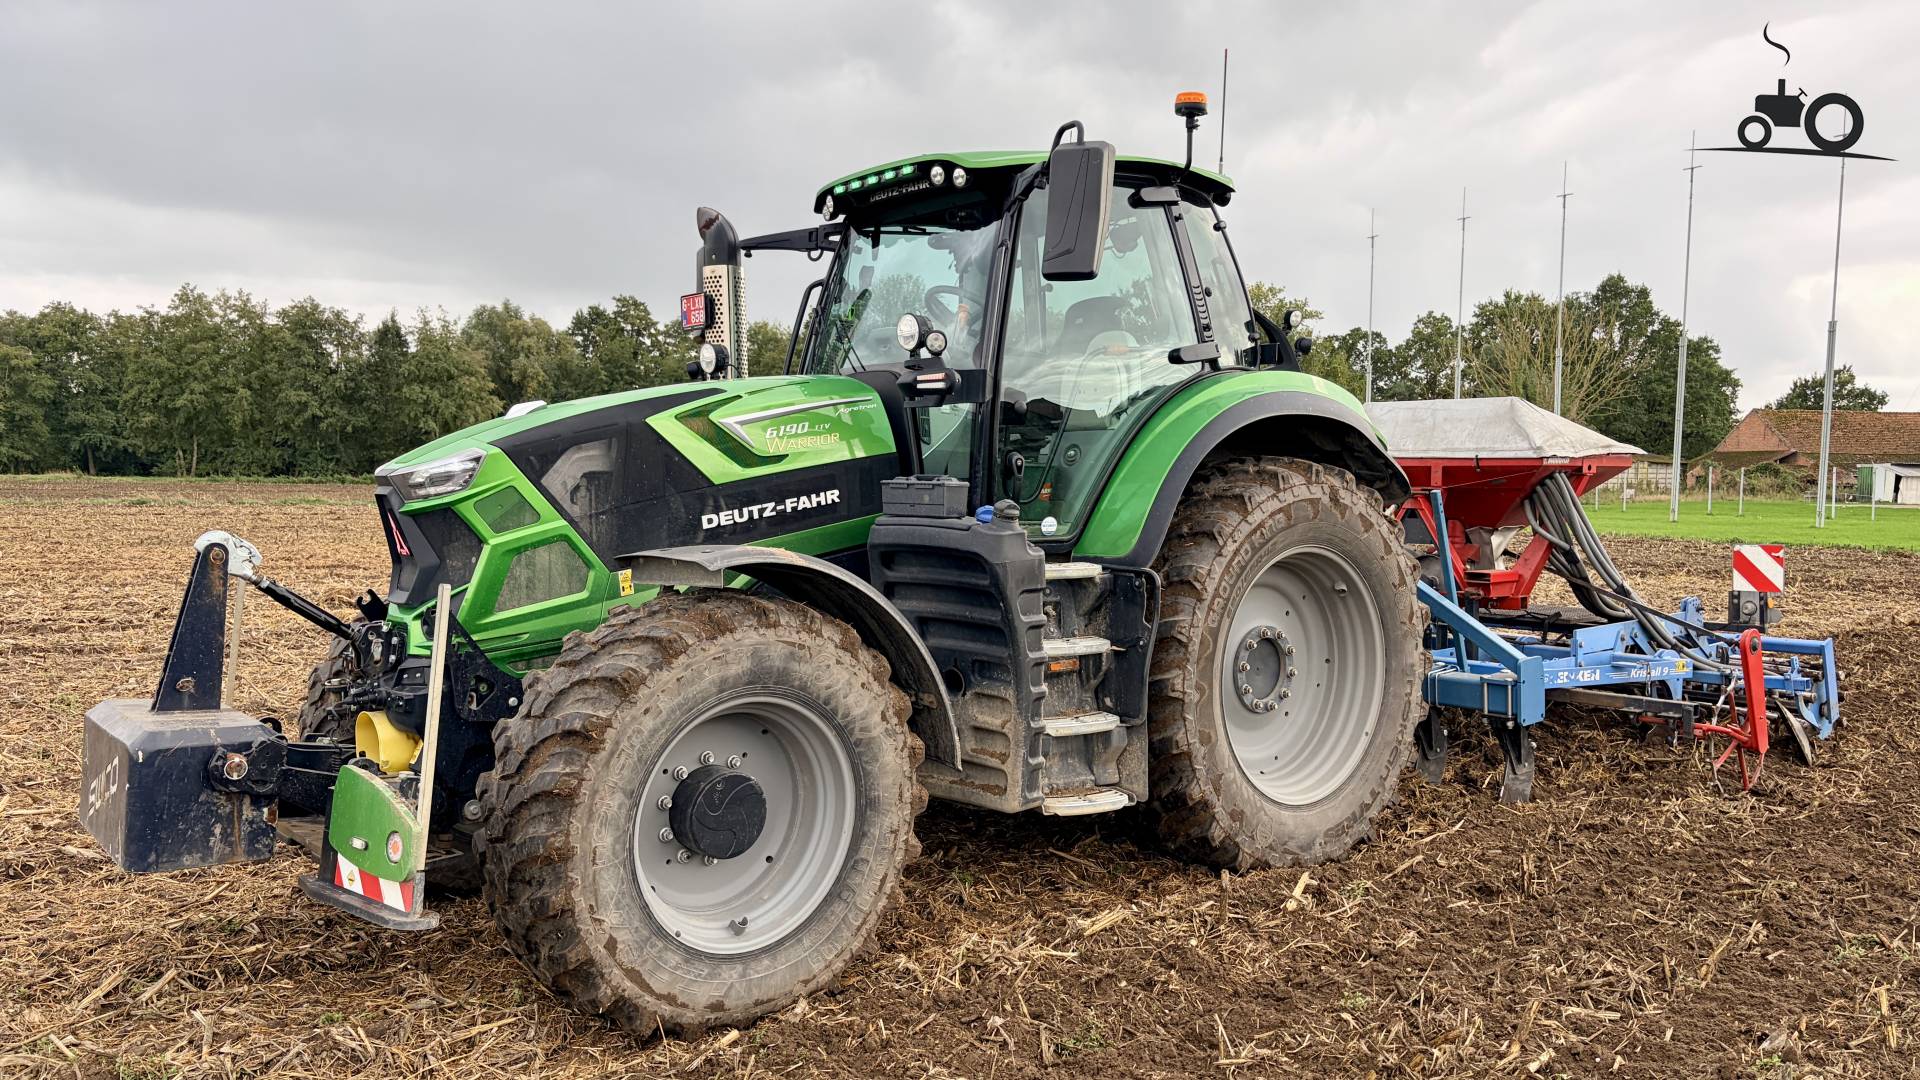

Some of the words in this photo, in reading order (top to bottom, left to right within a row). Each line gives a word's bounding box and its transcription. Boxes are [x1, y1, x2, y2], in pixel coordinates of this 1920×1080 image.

[765, 422, 809, 439] 6190
[701, 489, 841, 530] DEUTZ-FAHR
[1662, 666, 1669, 677] 9
